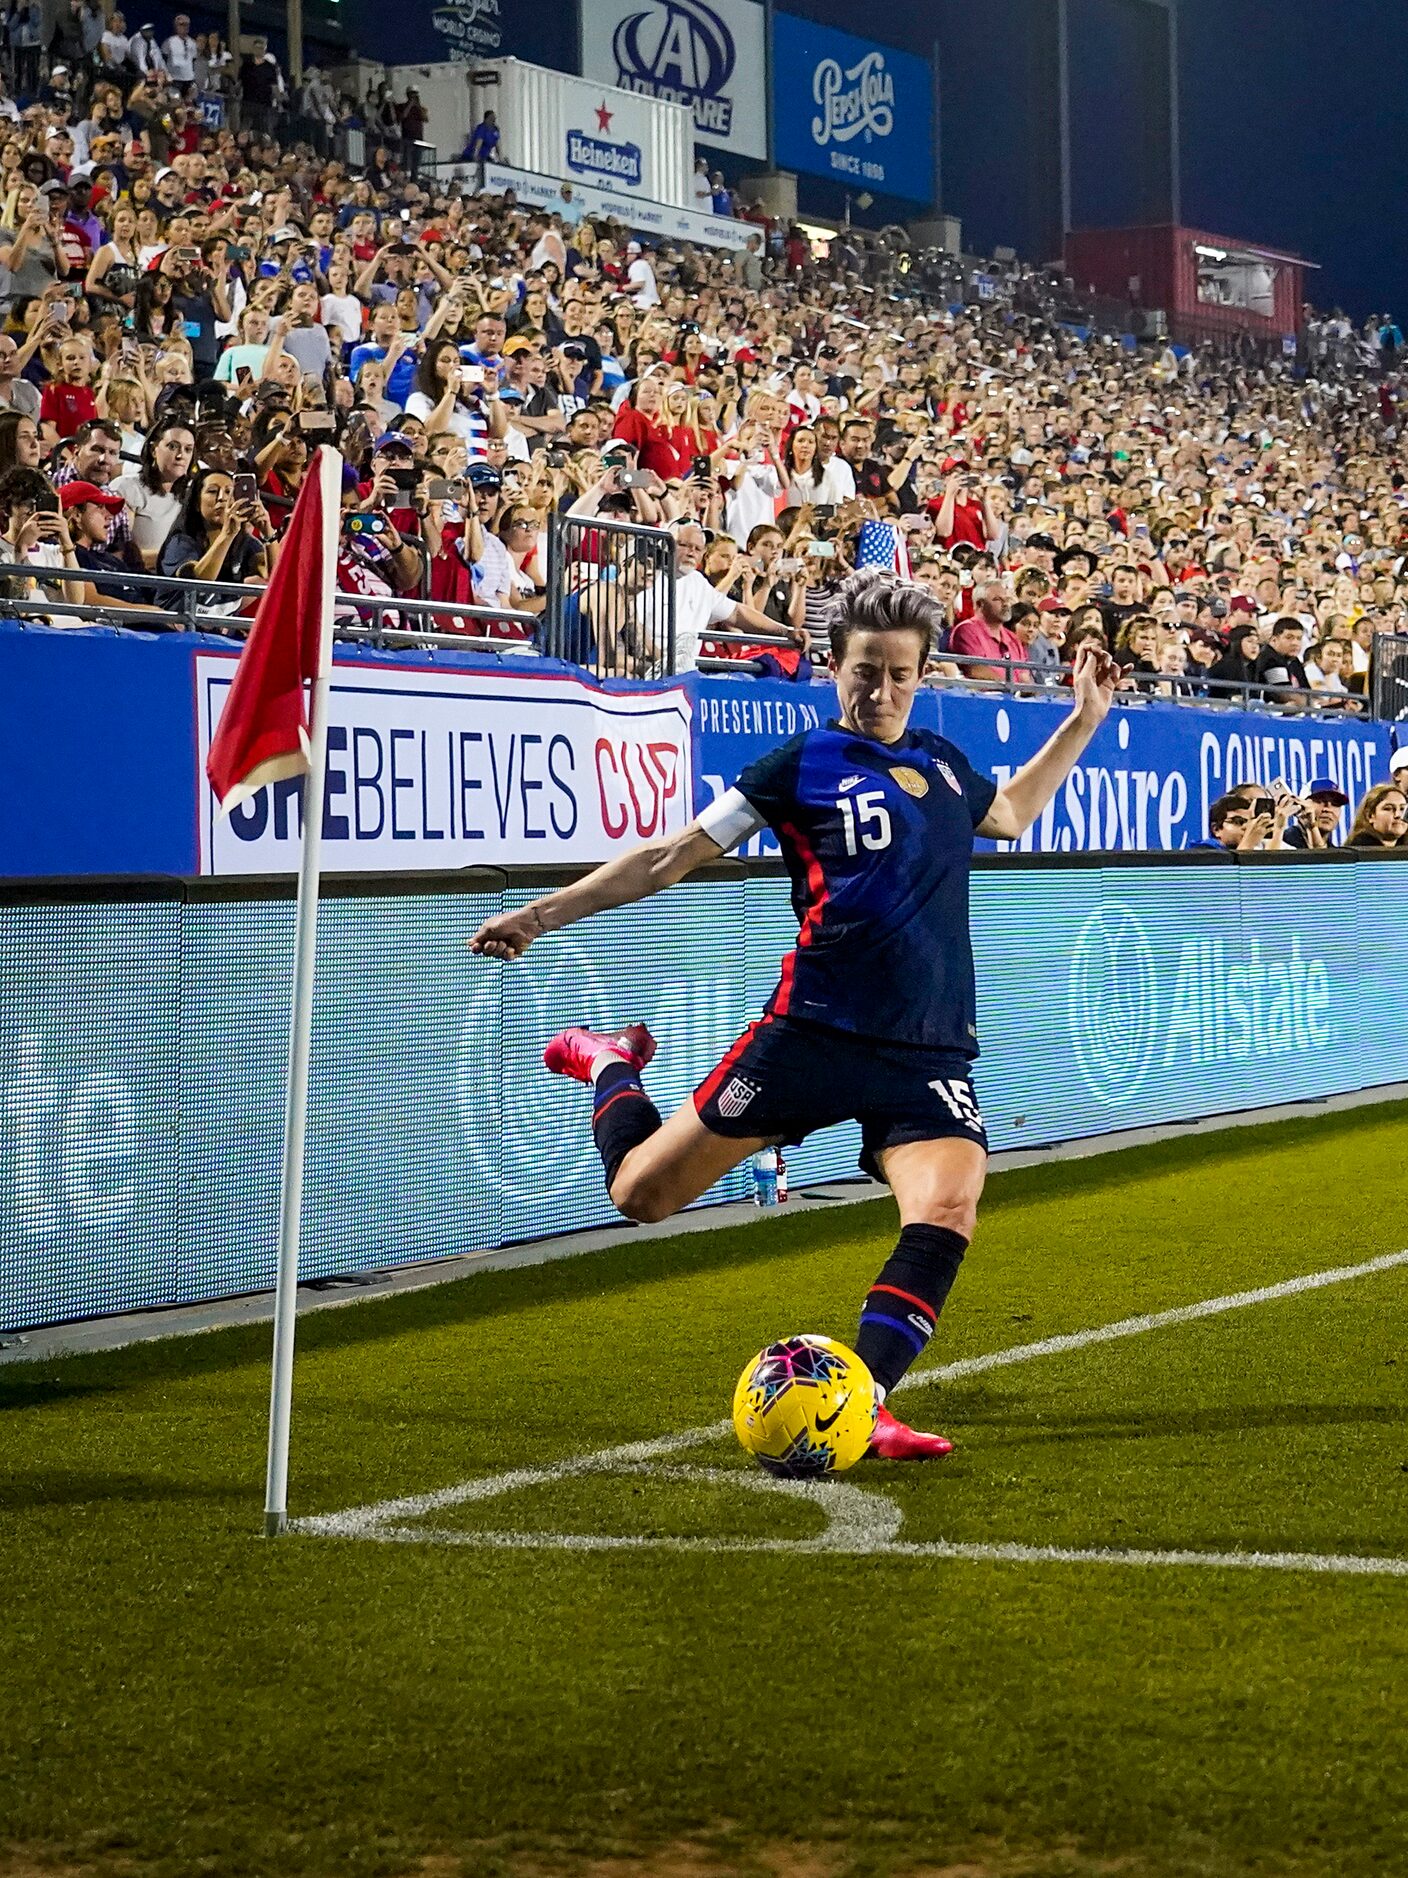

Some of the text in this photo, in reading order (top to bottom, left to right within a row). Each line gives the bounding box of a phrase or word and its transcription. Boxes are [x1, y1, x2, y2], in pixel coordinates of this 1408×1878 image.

[570, 137, 638, 178] Heineken
[700, 698, 820, 735] PRESENTED BY
[595, 736, 679, 840] CUP
[836, 790, 892, 856] 15
[1164, 935, 1334, 1067] Allstate
[729, 1080, 751, 1101] USA
[927, 1079, 984, 1133] 15
